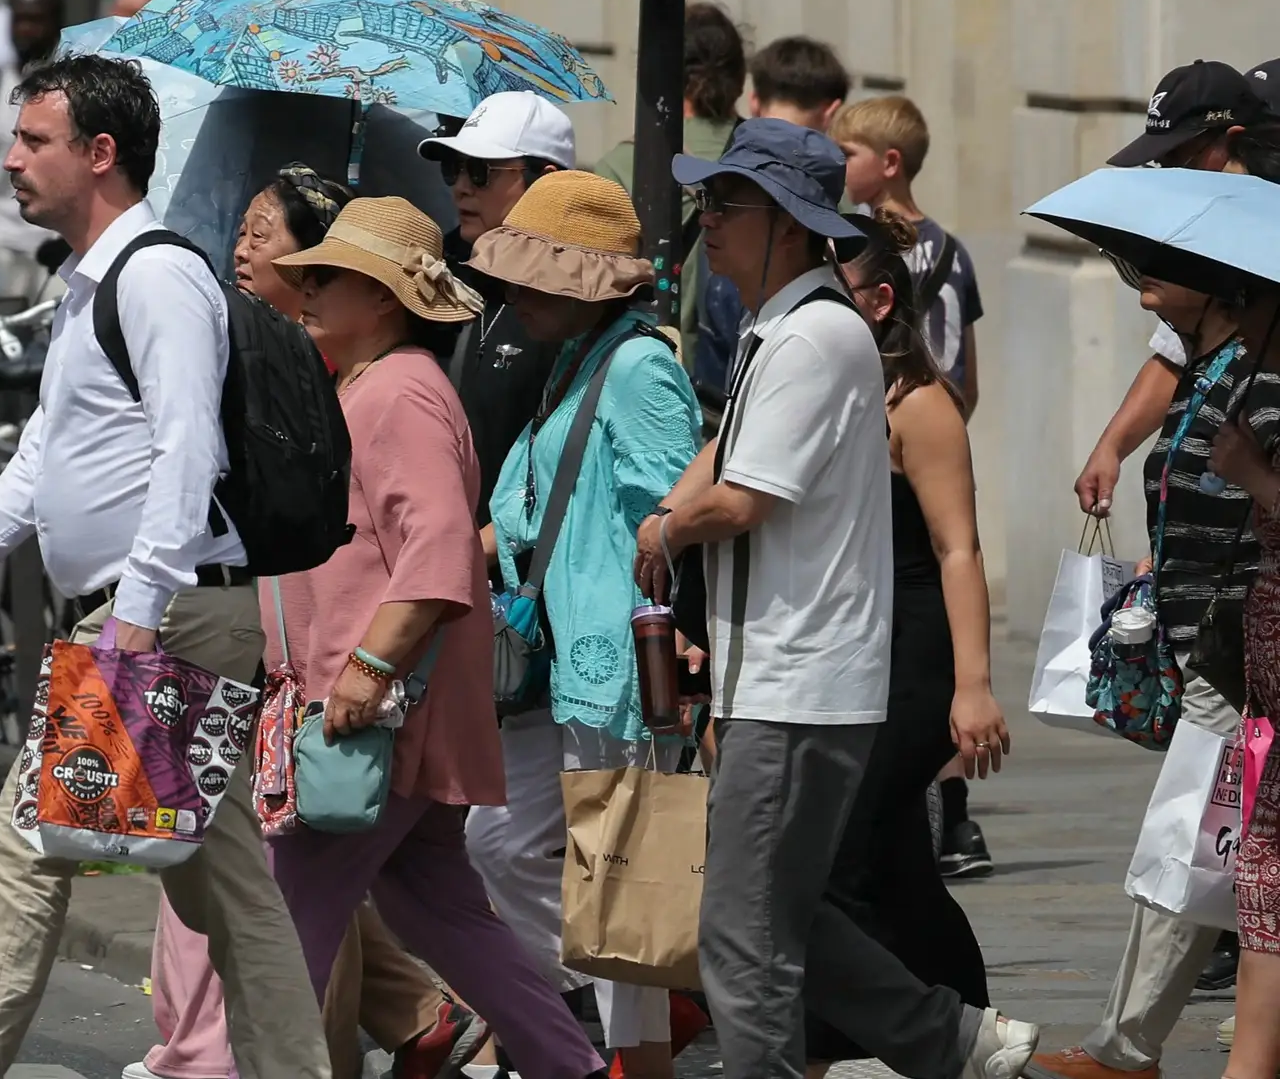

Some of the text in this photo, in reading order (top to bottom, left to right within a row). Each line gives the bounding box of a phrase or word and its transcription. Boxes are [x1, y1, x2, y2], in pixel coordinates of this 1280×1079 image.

[144, 691, 189, 716] TASTY
[77, 756, 99, 768] 100%
[602, 853, 629, 866] WITH
